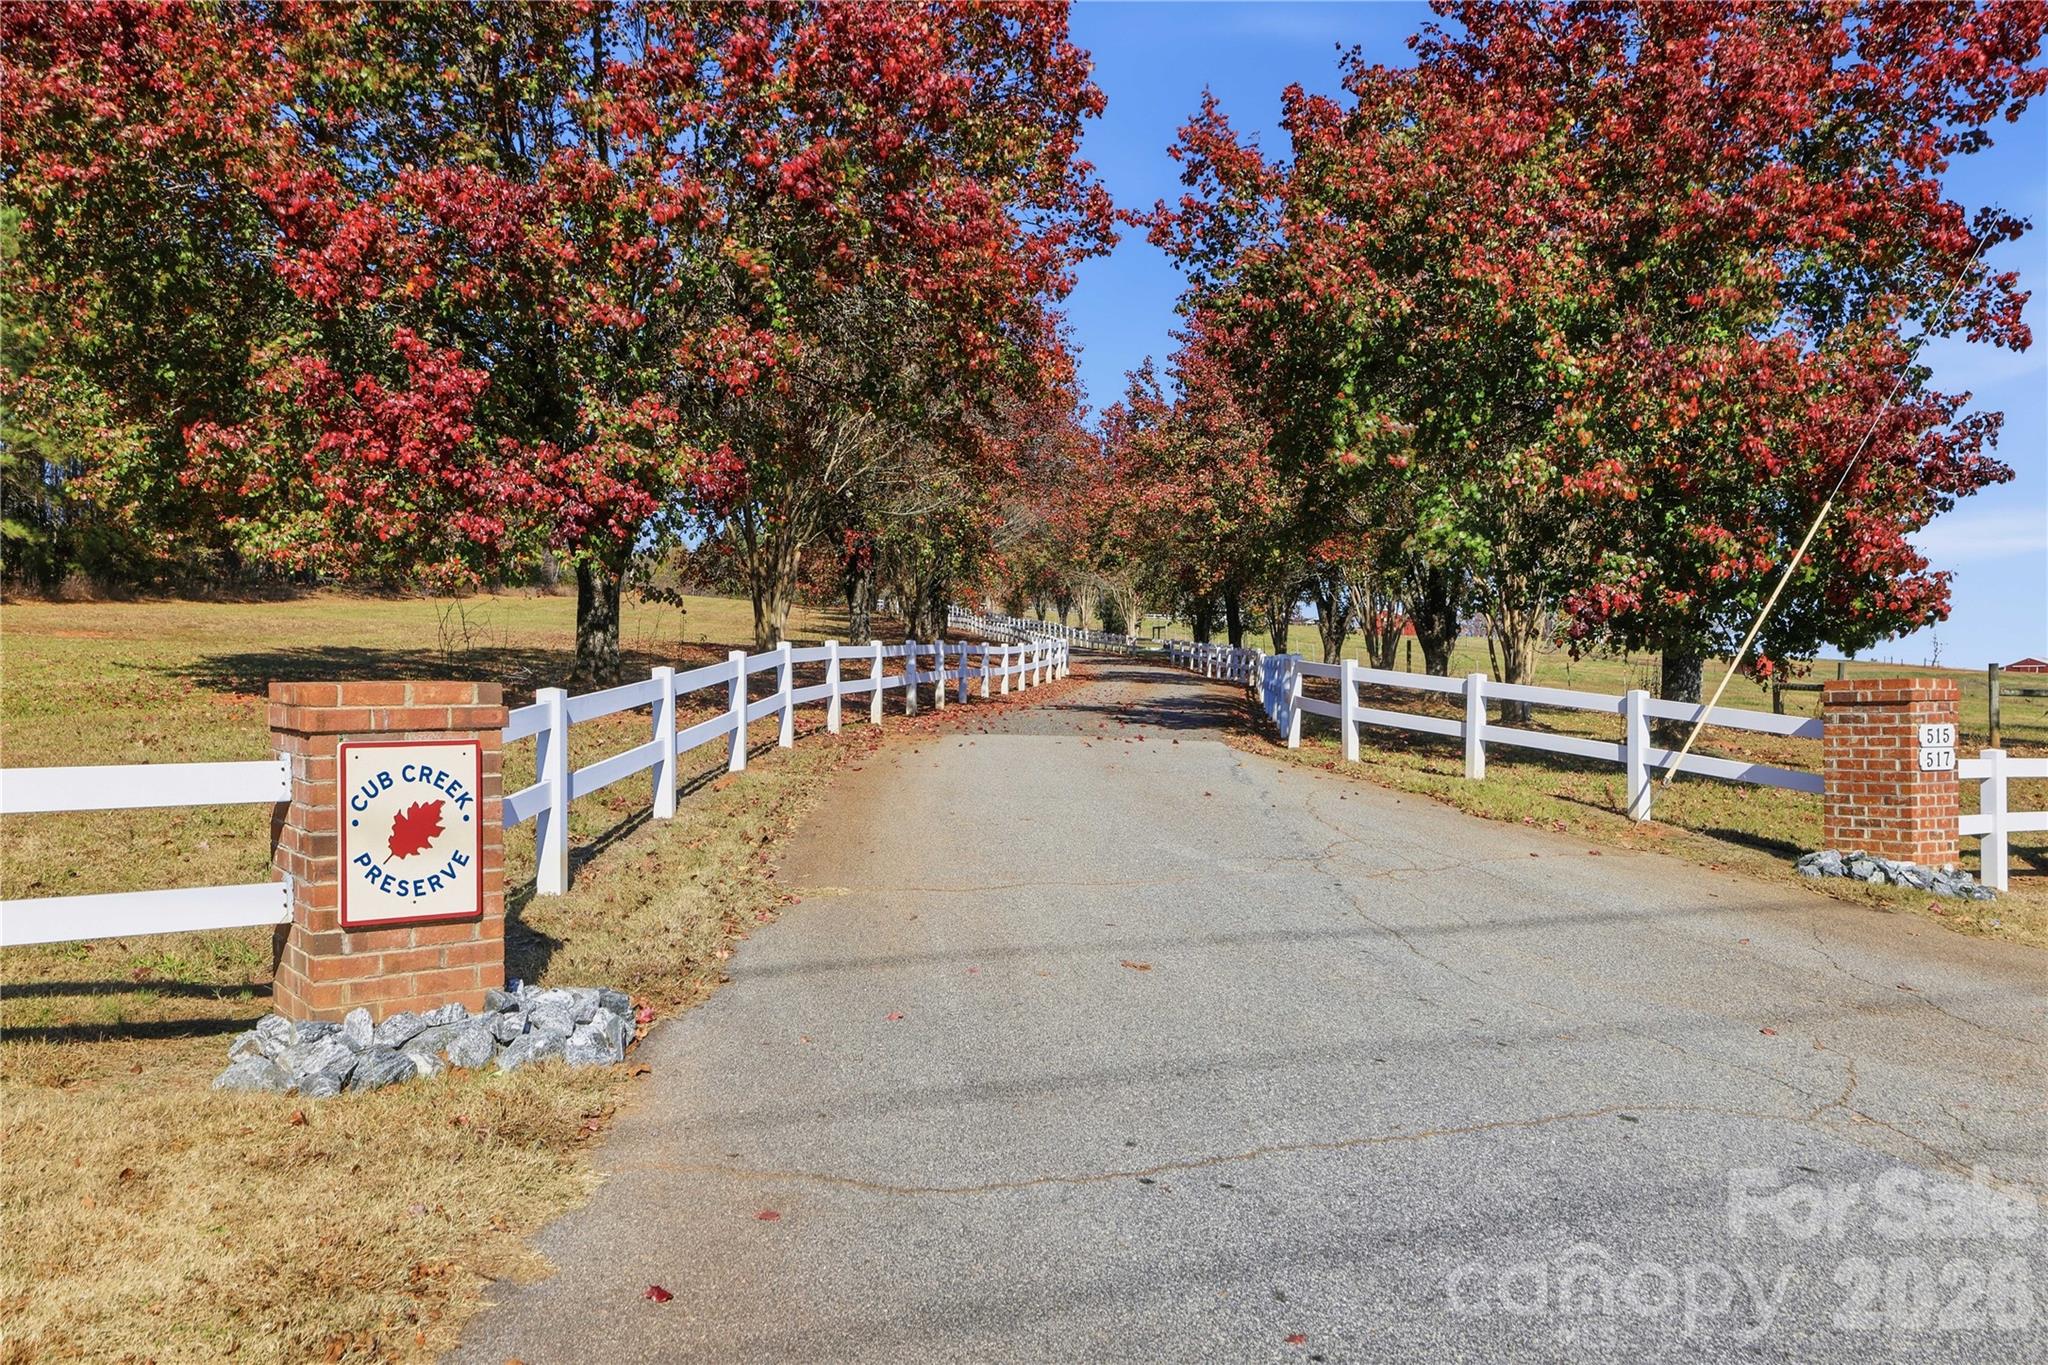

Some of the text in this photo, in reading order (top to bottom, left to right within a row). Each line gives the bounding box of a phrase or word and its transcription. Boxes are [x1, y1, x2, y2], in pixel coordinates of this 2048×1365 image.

[1927, 728, 1950, 744] 515
[1926, 751, 1950, 768] 517
[351, 764, 474, 811] CUB CREEK
[353, 849, 470, 896] PRESERVE
